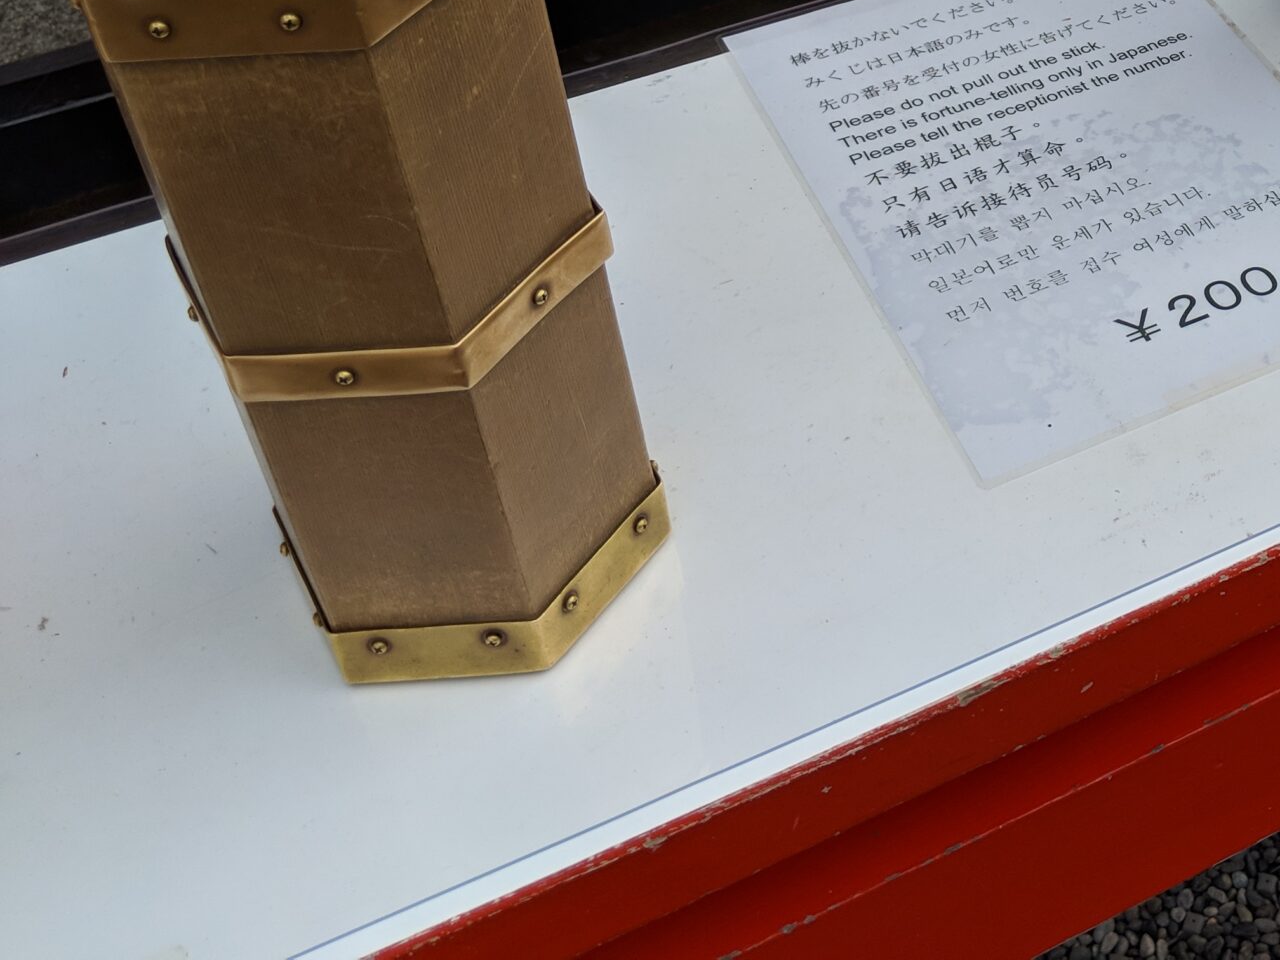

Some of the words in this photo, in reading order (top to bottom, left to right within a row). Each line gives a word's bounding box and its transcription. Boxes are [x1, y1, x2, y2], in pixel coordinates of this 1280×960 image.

[828, 106, 896, 133] Please
[899, 97, 925, 111] do
[927, 84, 960, 103] not
[961, 73, 995, 94] pull
[997, 63, 1028, 80] out
[1028, 55, 1058, 70] the
[1061, 41, 1106, 60] stick.
[836, 125, 897, 149] There
[899, 118, 919, 130] is
[920, 78, 1045, 124] fortune-telling
[1047, 65, 1083, 83] only
[1084, 59, 1105, 71] in
[1108, 32, 1193, 64] Japanese.
[848, 138, 917, 166] Please
[919, 125, 950, 143] tell
[951, 117, 984, 133] the
[986, 80, 1091, 122] receptionist
[1090, 73, 1120, 88] the
[1122, 50, 1193, 78] number.
[909, 226, 999, 263] 막대기를
[1008, 206, 1053, 232] 뽑지
[1061, 177, 1152, 210] 마십시오.
[928, 244, 1041, 294] 일본어로만
[1051, 218, 1113, 251] 운세가
[1122, 186, 1212, 225] 있습니다.
[945, 296, 992, 323] 먼저
[1002, 269, 1070, 303] 번호를
[1079, 251, 1122, 274] 접수
[1132, 215, 1219, 253] 여성에게
